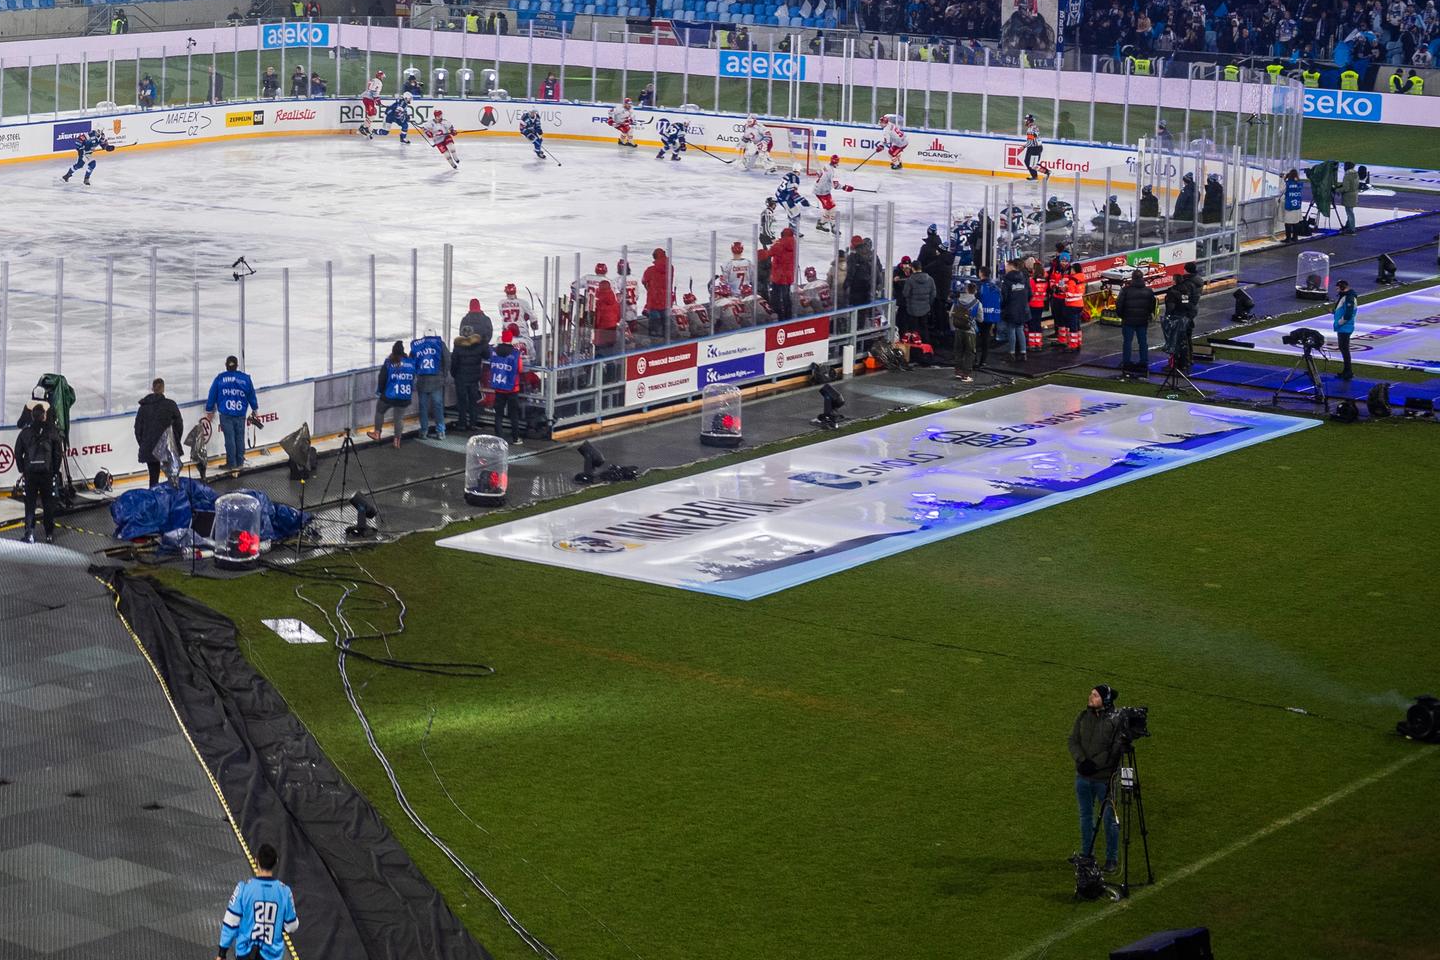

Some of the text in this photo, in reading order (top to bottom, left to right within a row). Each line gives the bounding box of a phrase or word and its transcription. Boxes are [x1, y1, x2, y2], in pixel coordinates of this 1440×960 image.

[267, 23, 323, 48] aseko
[725, 51, 798, 79] aseko
[165, 111, 200, 125] MAFLEX
[229, 115, 252, 123] ZEPPELIN
[254, 113, 264, 122] CAT
[187, 125, 199, 136] CZ
[716, 133, 739, 143] Auto
[917, 150, 959, 159] POLANSKY
[1039, 157, 1090, 173] aufland
[736, 272, 745, 290] 7
[501, 308, 520, 322] 27
[222, 388, 245, 397] PHOTO
[394, 383, 411, 395] 138
[225, 399, 243, 411] 096
[81, 442, 113, 457] STEEL
[254, 901, 279, 925] 20
